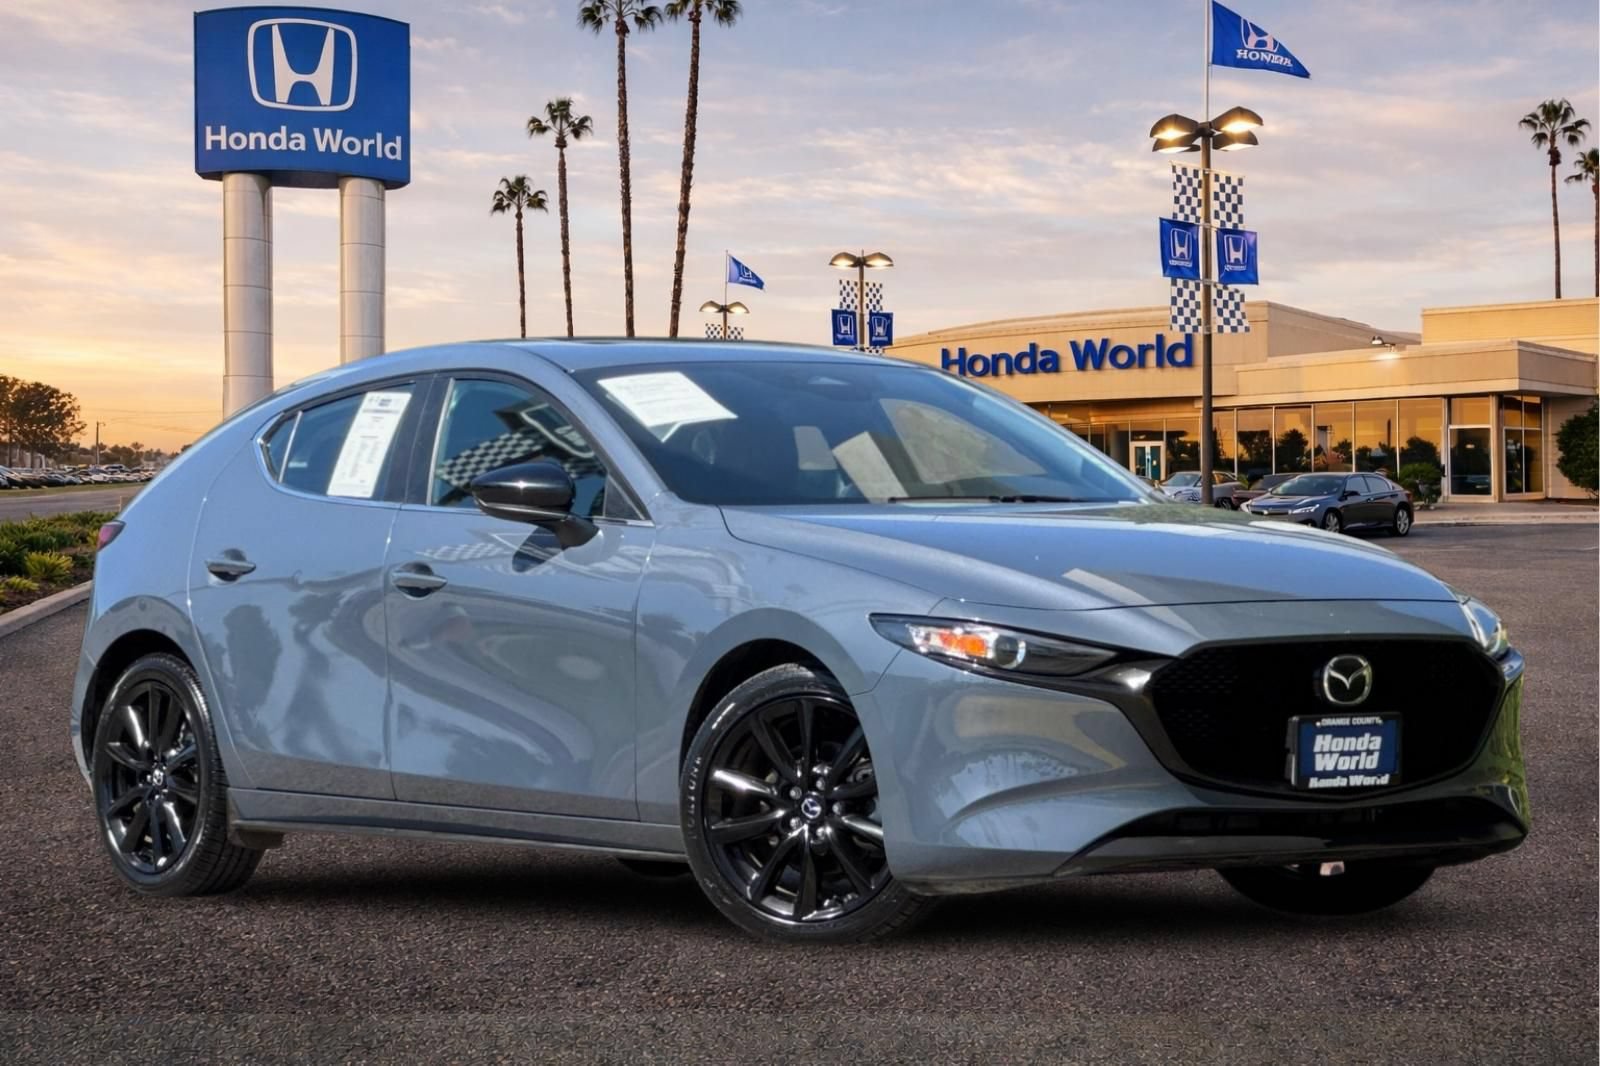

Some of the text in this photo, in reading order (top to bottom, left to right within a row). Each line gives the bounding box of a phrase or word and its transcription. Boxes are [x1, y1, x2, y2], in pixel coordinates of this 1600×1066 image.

[1236, 49, 1293, 66] HONDA
[205, 125, 402, 160] Honda World
[941, 333, 1193, 376] Honda World
[1320, 717, 1350, 726] ORANGE
[1313, 733, 1382, 752] Honda
[1315, 751, 1380, 771] World
[1309, 775, 1348, 789] Honda
